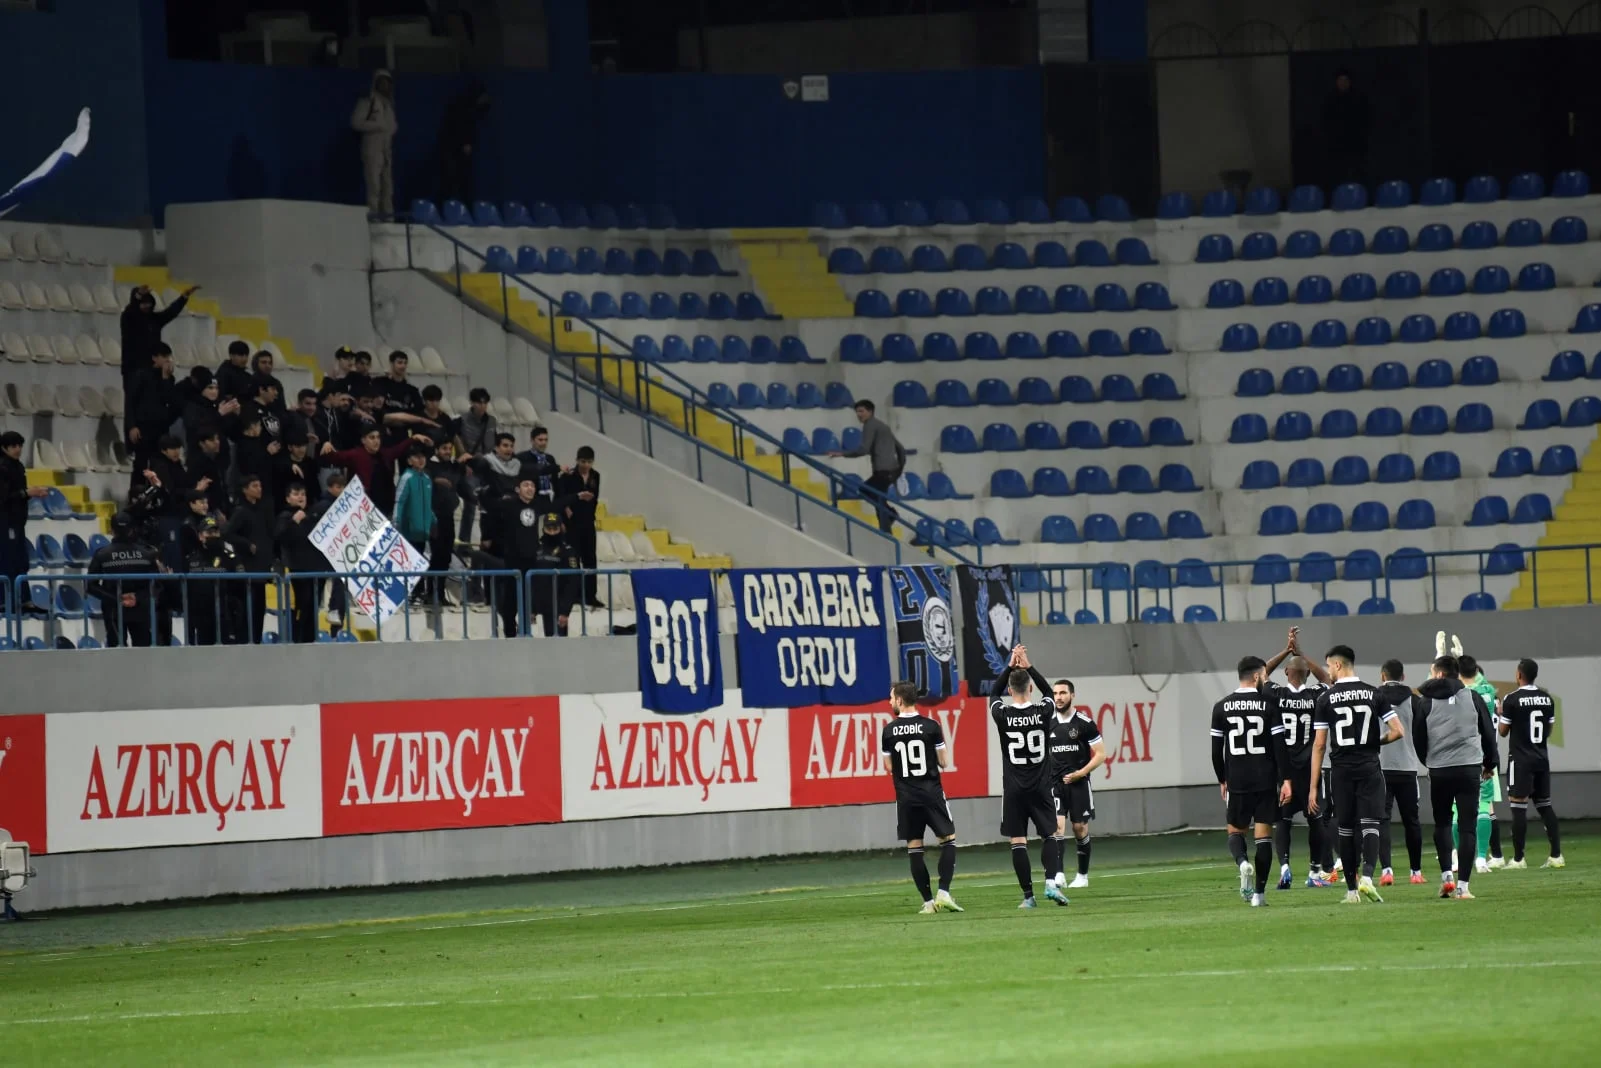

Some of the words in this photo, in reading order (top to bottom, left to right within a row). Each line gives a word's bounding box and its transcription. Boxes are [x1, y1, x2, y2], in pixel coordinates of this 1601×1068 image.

[111, 551, 143, 560] POLIS
[743, 568, 880, 634] QARABAĞ
[777, 636, 856, 688] ORDU
[1329, 689, 1374, 704] BAYRAMOV
[1226, 715, 1266, 755] 22
[1282, 713, 1312, 746] 91
[1333, 705, 1373, 747] 27
[1530, 710, 1544, 743] 6
[591, 717, 762, 801] AZERÇAY
[895, 739, 927, 777] 19
[1005, 730, 1045, 764] 29
[80, 738, 291, 832] AZERÇAY
[340, 727, 529, 817] AZERÇAY
